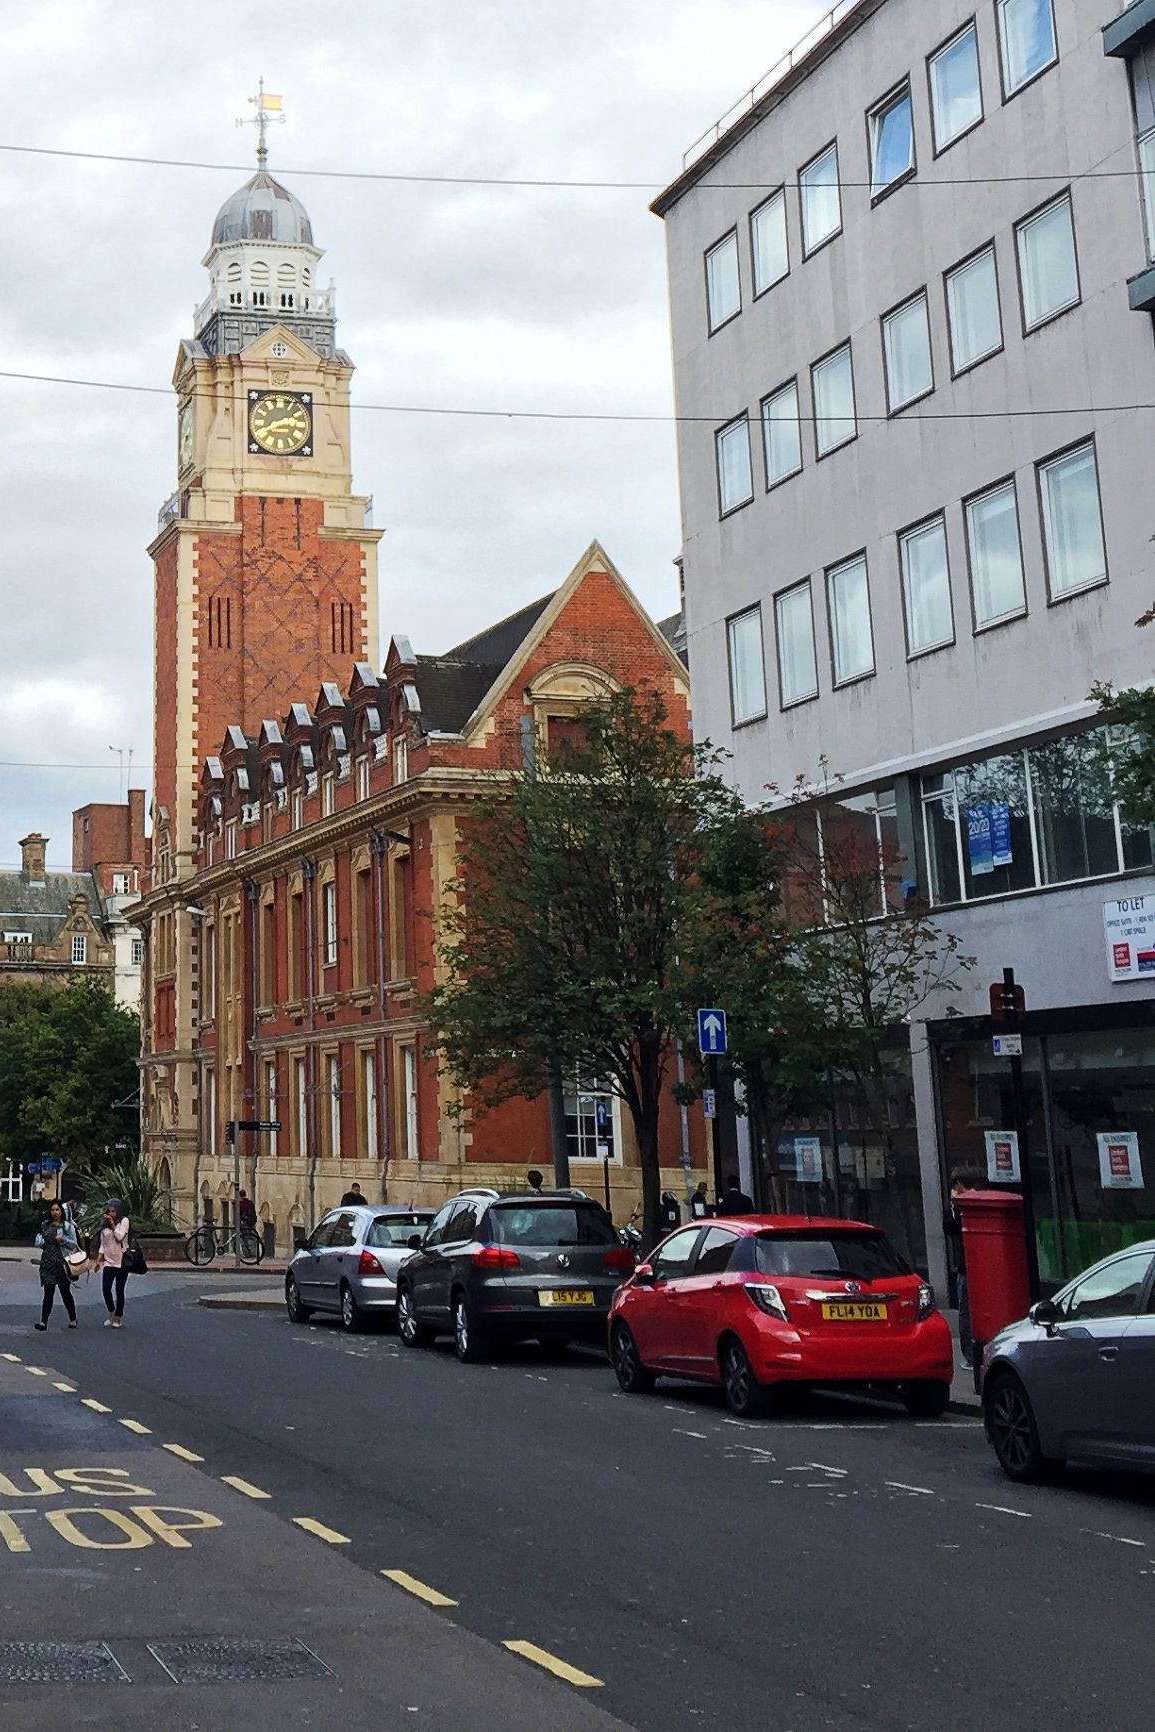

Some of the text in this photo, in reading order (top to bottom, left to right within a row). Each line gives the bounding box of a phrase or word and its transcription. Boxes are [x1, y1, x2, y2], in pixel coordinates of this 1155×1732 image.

[1117, 897, 1144, 912] TO LET
[829, 1305, 855, 1317] FL14
